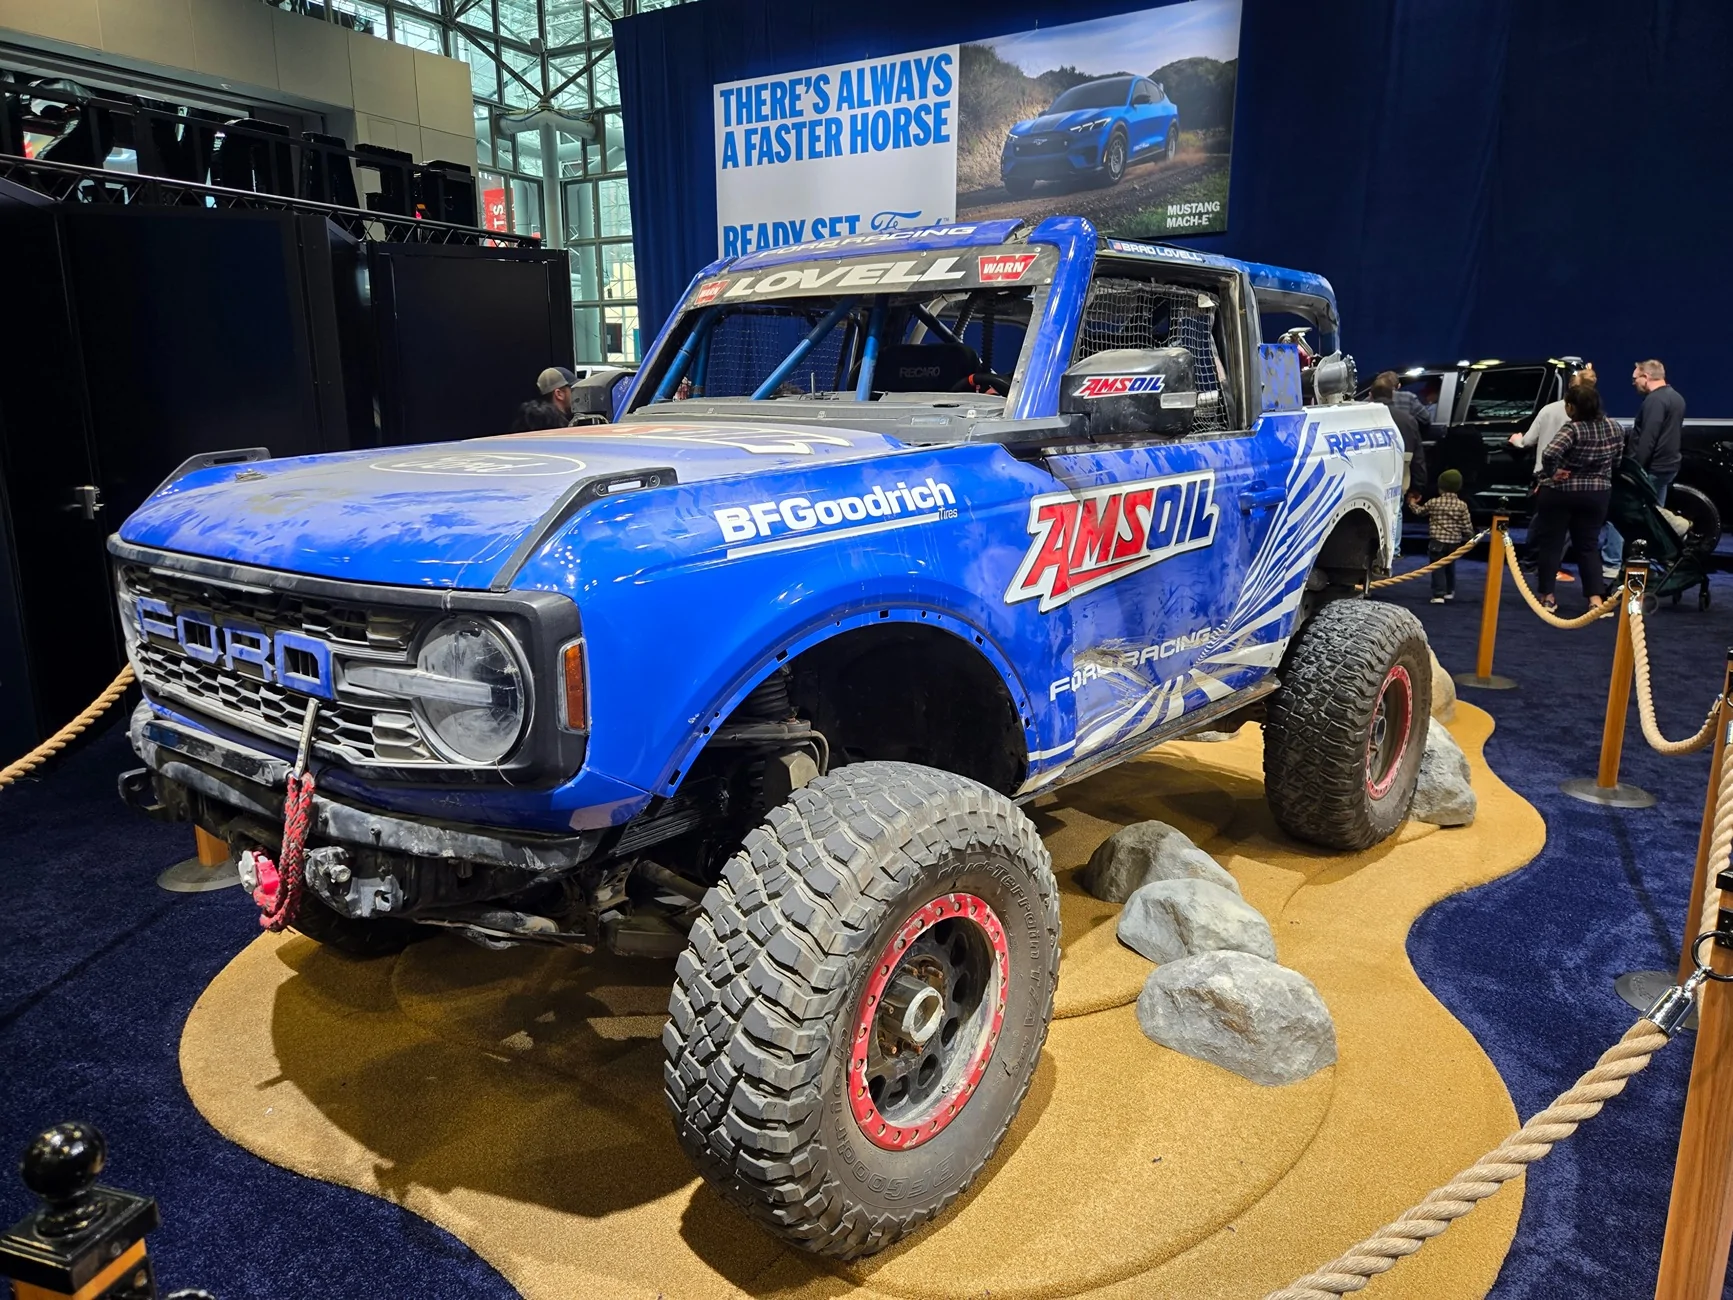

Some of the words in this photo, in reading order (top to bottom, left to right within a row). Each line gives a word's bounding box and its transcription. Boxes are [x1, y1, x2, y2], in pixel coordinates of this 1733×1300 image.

[719, 73, 830, 127] THERE'S
[836, 53, 953, 111] ALWAYS
[722, 131, 739, 170] A
[744, 116, 843, 167] FASTER
[849, 102, 951, 155] HORSE
[1167, 201, 1220, 216] MUSTANG
[723, 219, 806, 259] READY
[811, 214, 860, 245] SET
[837, 226, 978, 249] RACING
[1121, 242, 1156, 256] BRAD
[1157, 247, 1203, 261] LOVELL
[723, 256, 967, 298] LOVELL
[899, 365, 941, 378] RECARO
[1079, 376, 1165, 397] AMSOIL
[1323, 427, 1402, 462] RAPTOR
[713, 477, 957, 543] BFGoodrich
[938, 506, 959, 521] Tires
[1020, 477, 1214, 600] AMSOIL
[136, 595, 333, 700] FORD
[1121, 627, 1212, 667] RACING
[937, 860, 1041, 961] Mud-Terrain
[829, 1027, 956, 1200] BFGoodrich
